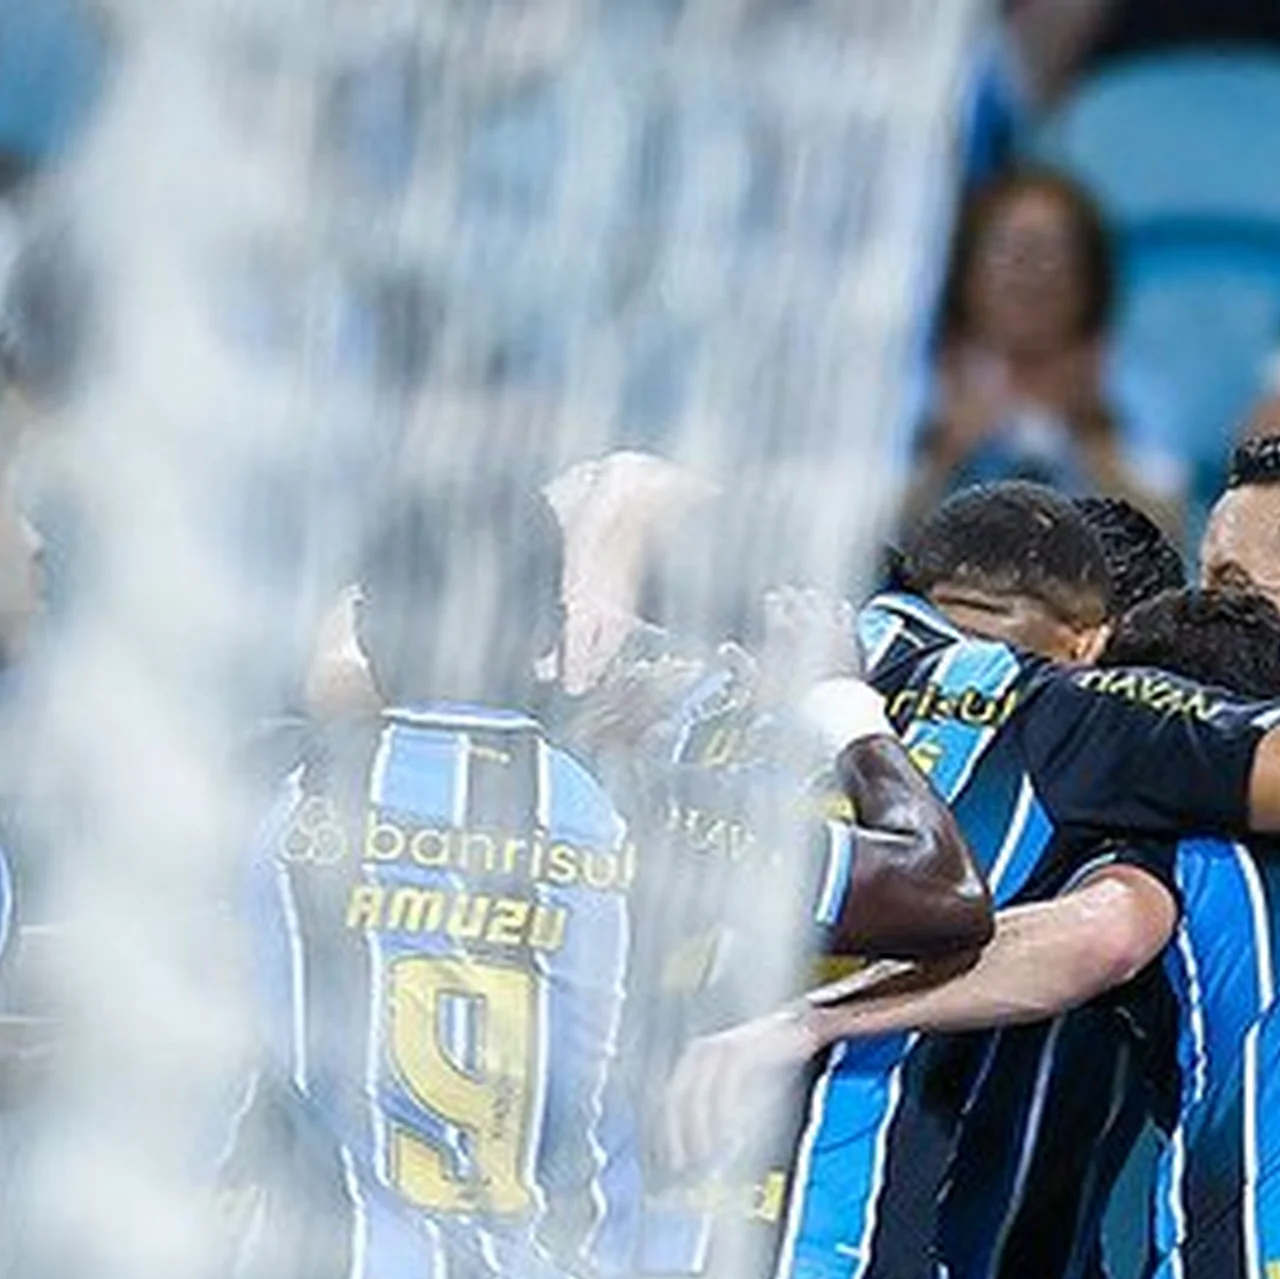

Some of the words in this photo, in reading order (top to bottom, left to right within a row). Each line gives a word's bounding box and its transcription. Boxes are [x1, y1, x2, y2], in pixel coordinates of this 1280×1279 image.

[364, 808, 636, 891] banrisul
[346, 884, 566, 952] AMUZU
[385, 955, 533, 1212] 9
